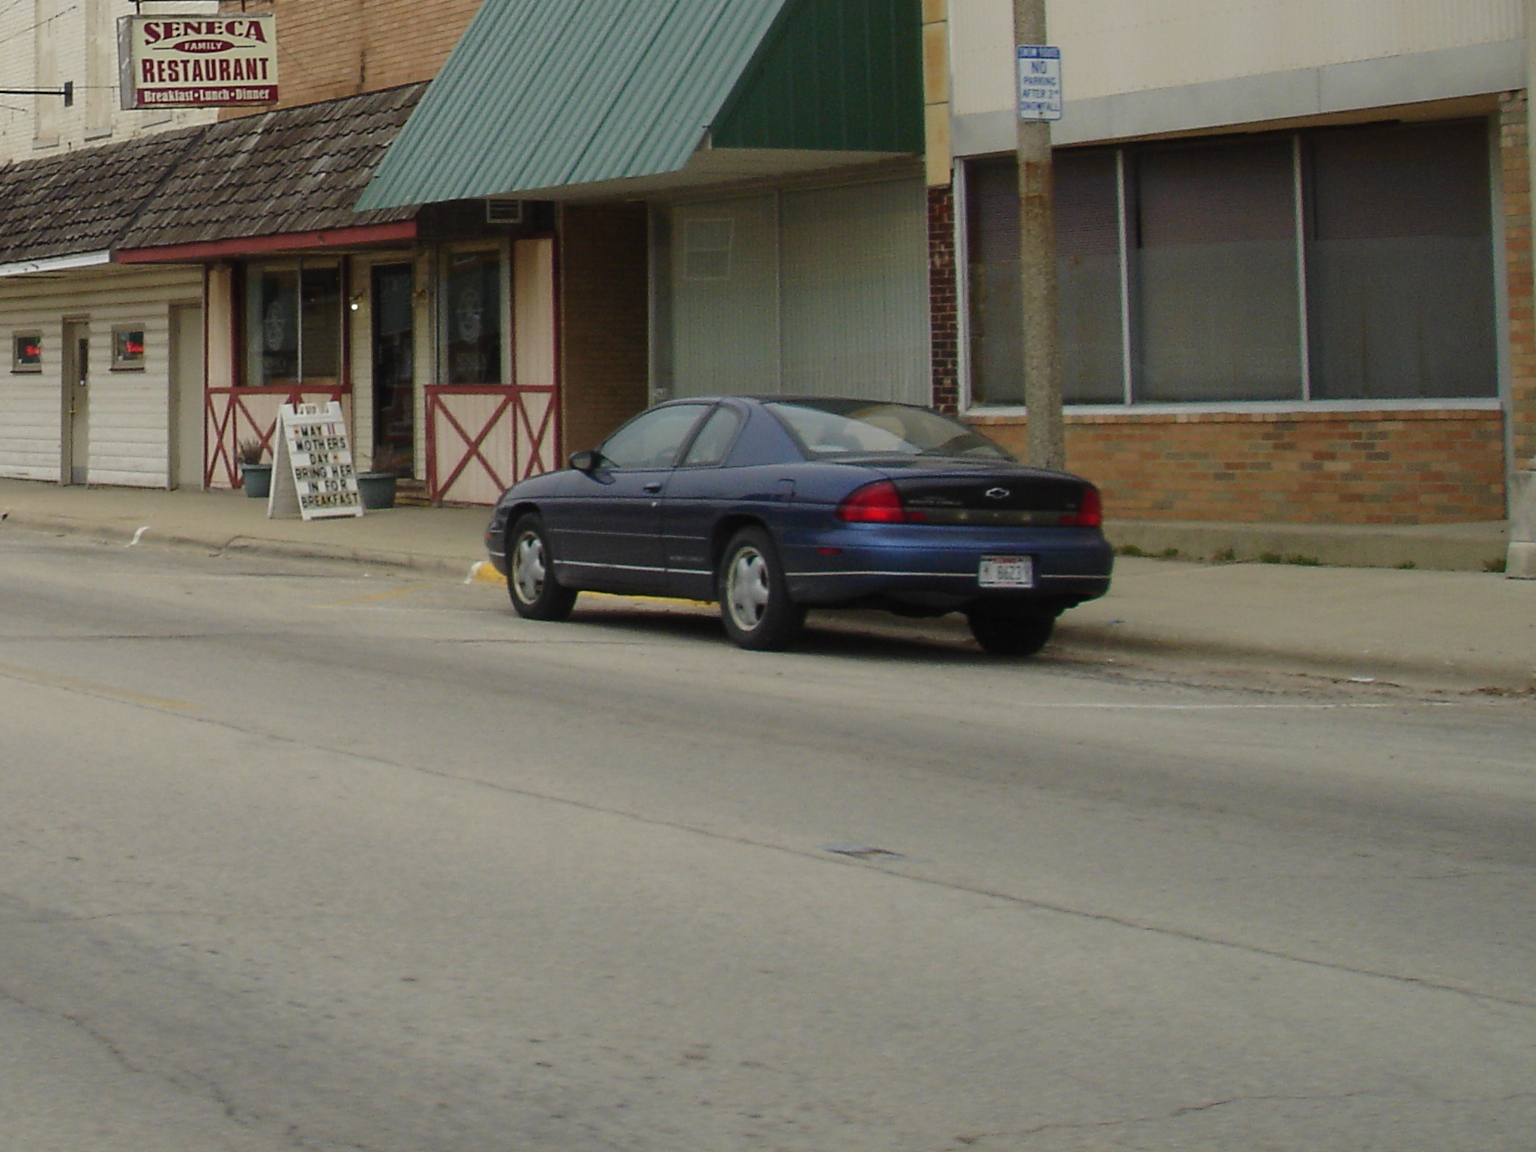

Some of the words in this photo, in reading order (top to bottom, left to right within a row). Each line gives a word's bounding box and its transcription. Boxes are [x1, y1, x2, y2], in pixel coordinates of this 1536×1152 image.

[143, 21, 267, 45] SENECA
[184, 42, 222, 50] FAMILY
[141, 58, 269, 83] RESTAURANT
[1031, 60, 1047, 74] NO
[144, 89, 194, 102] Breakfast
[199, 89, 230, 101] Lunch
[235, 88, 270, 100] Dinner
[301, 426, 322, 436] MAY
[296, 438, 345, 450] MOTHERS
[310, 453, 328, 465] DAY
[295, 468, 326, 480] BRING
[332, 465, 351, 477] HER
[308, 482, 319, 492] IN
[325, 480, 346, 490] FOR
[302, 493, 358, 507] BREAKFAST
